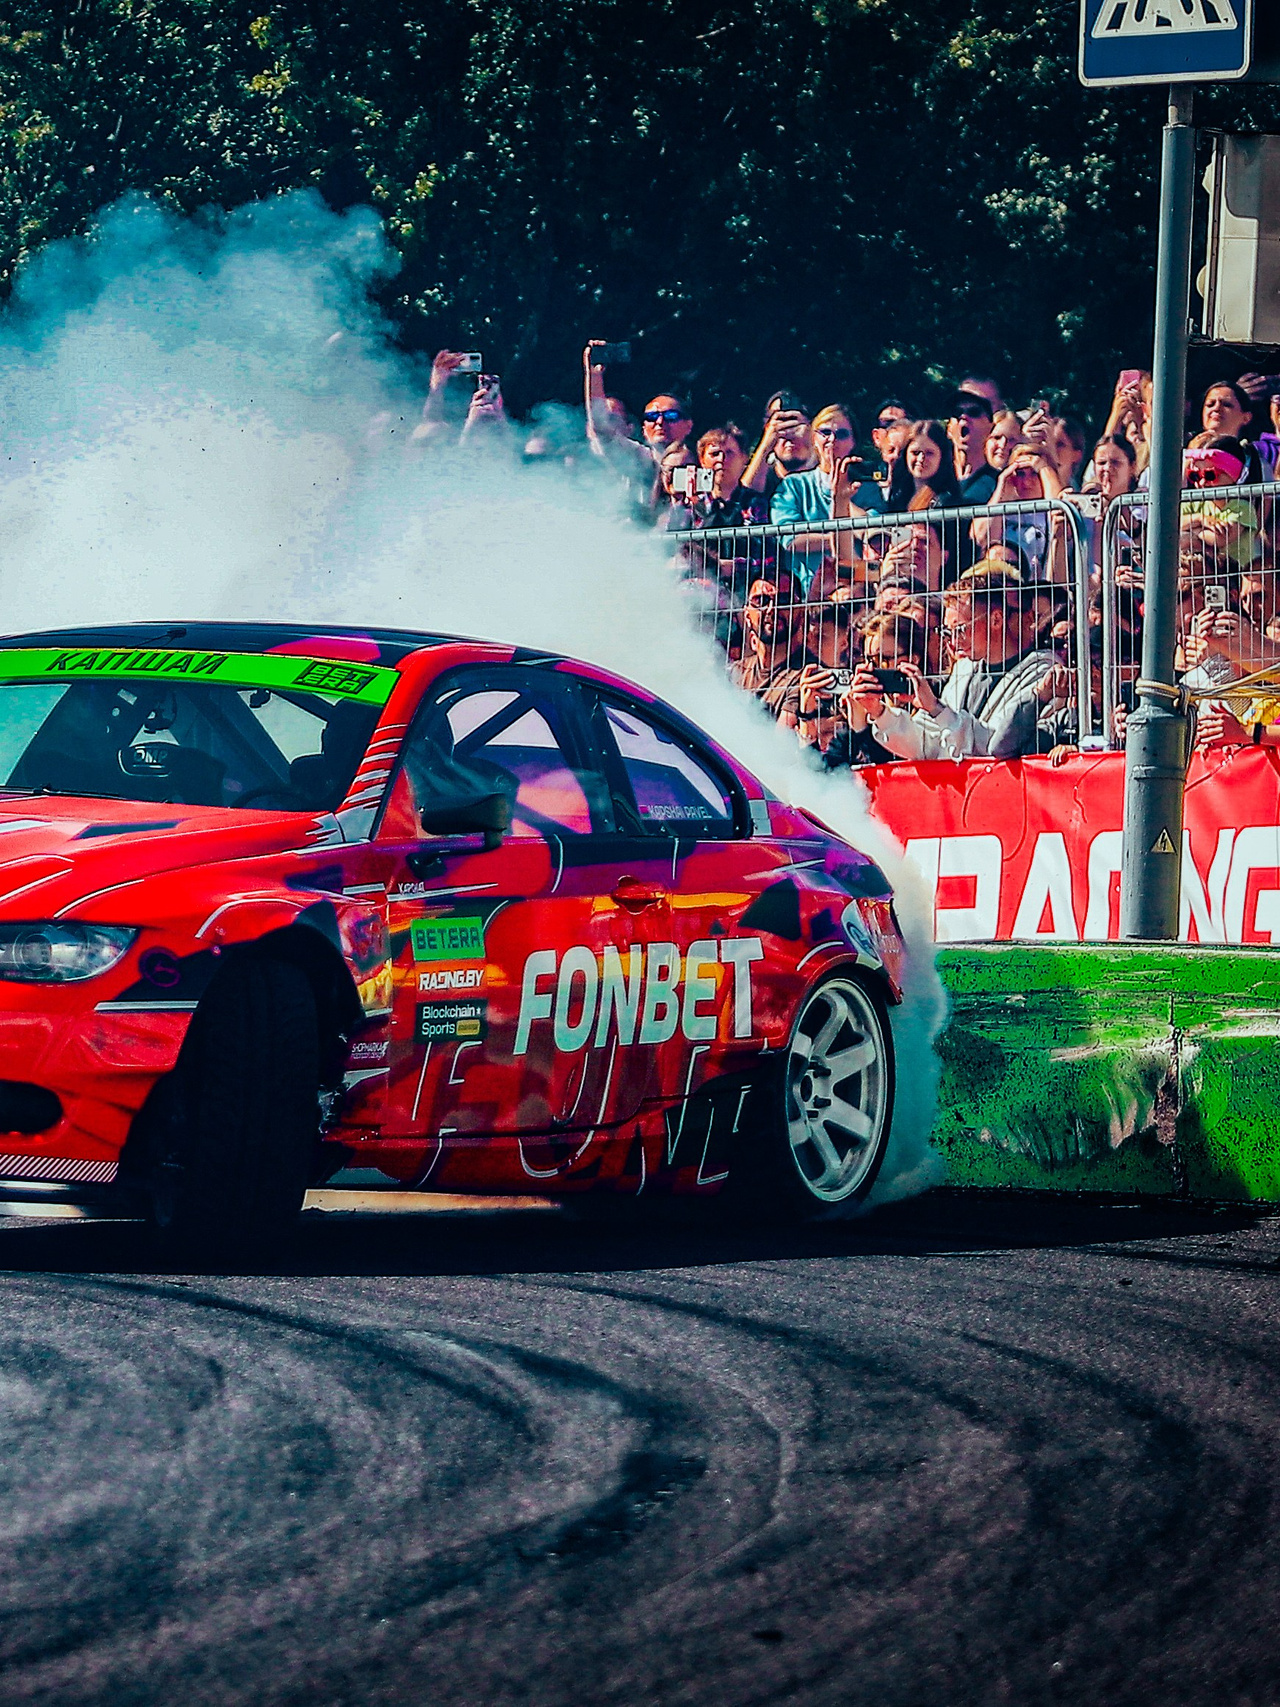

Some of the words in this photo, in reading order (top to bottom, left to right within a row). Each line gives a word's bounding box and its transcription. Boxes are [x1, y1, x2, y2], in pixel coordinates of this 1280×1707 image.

[310, 664, 370, 681] BET
[513, 937, 765, 1056] FONBET
[422, 1004, 476, 1019] Blockchain
[421, 1021, 456, 1038] Sports
